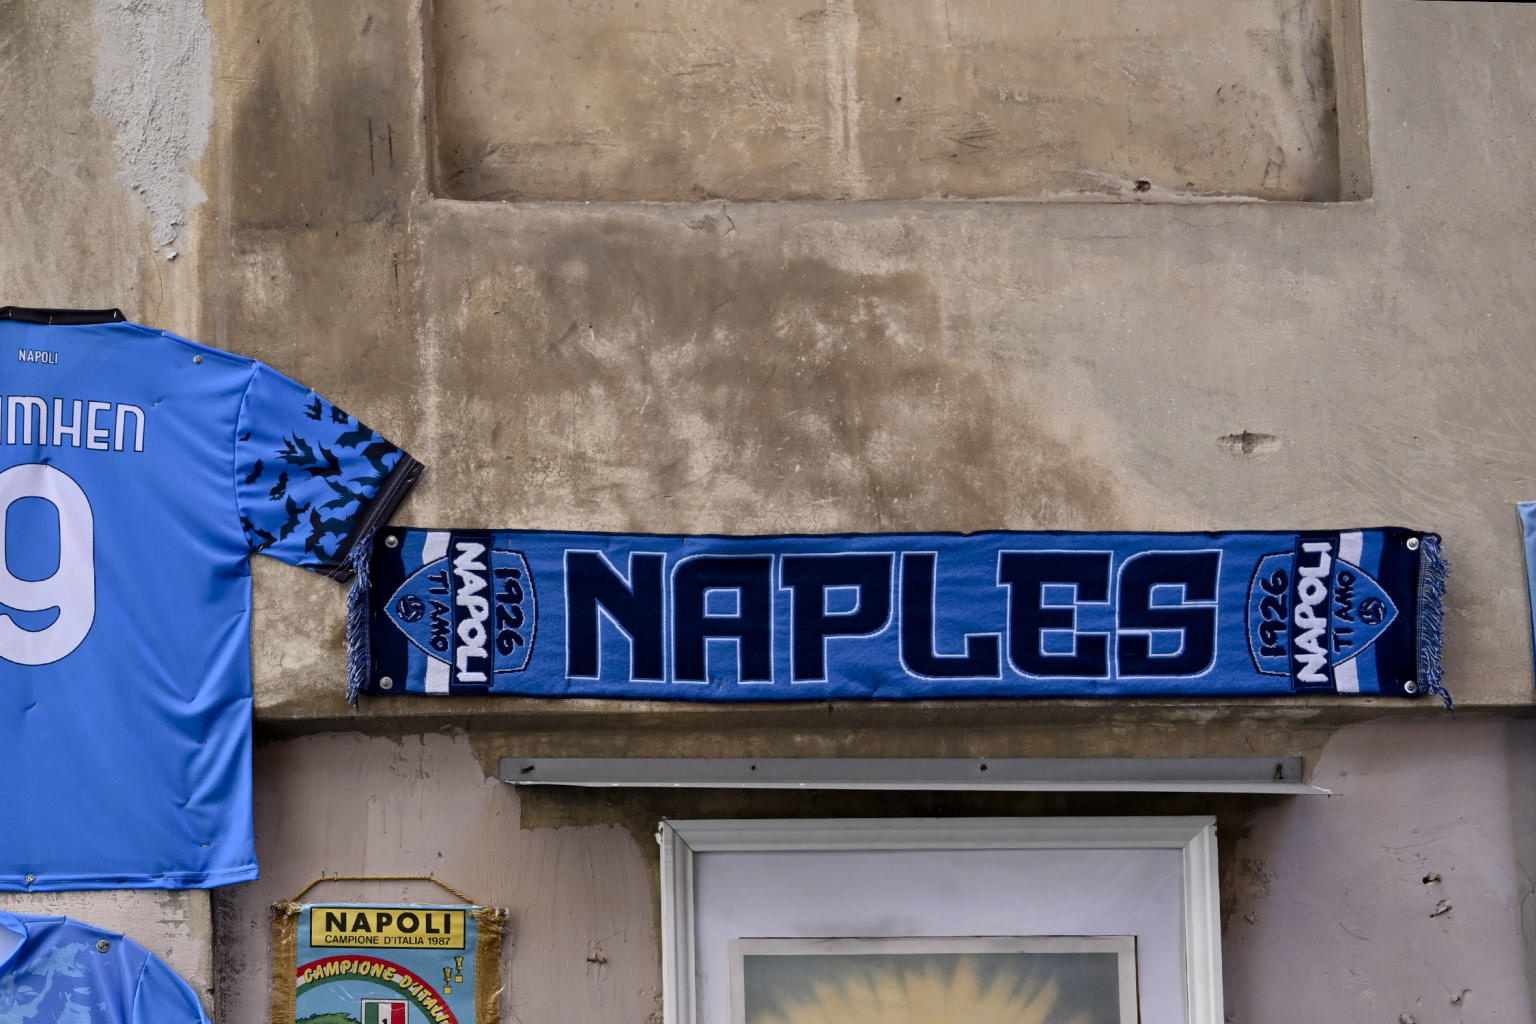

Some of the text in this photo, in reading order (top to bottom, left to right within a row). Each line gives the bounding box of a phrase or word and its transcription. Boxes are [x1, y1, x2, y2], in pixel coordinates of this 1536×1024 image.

[18, 349, 59, 365] NAPOLI
[453, 542, 490, 682] NAPOLI
[494, 567, 525, 656] 1926
[564, 548, 1223, 684] NAPLES
[1257, 568, 1289, 658] 1926
[1293, 541, 1333, 683] NAPOLI
[324, 934, 451, 946] CAMPIONE D'ITALIA 1987
[325, 911, 451, 934] NAPOLI
[303, 959, 397, 984] CAMPIONE
